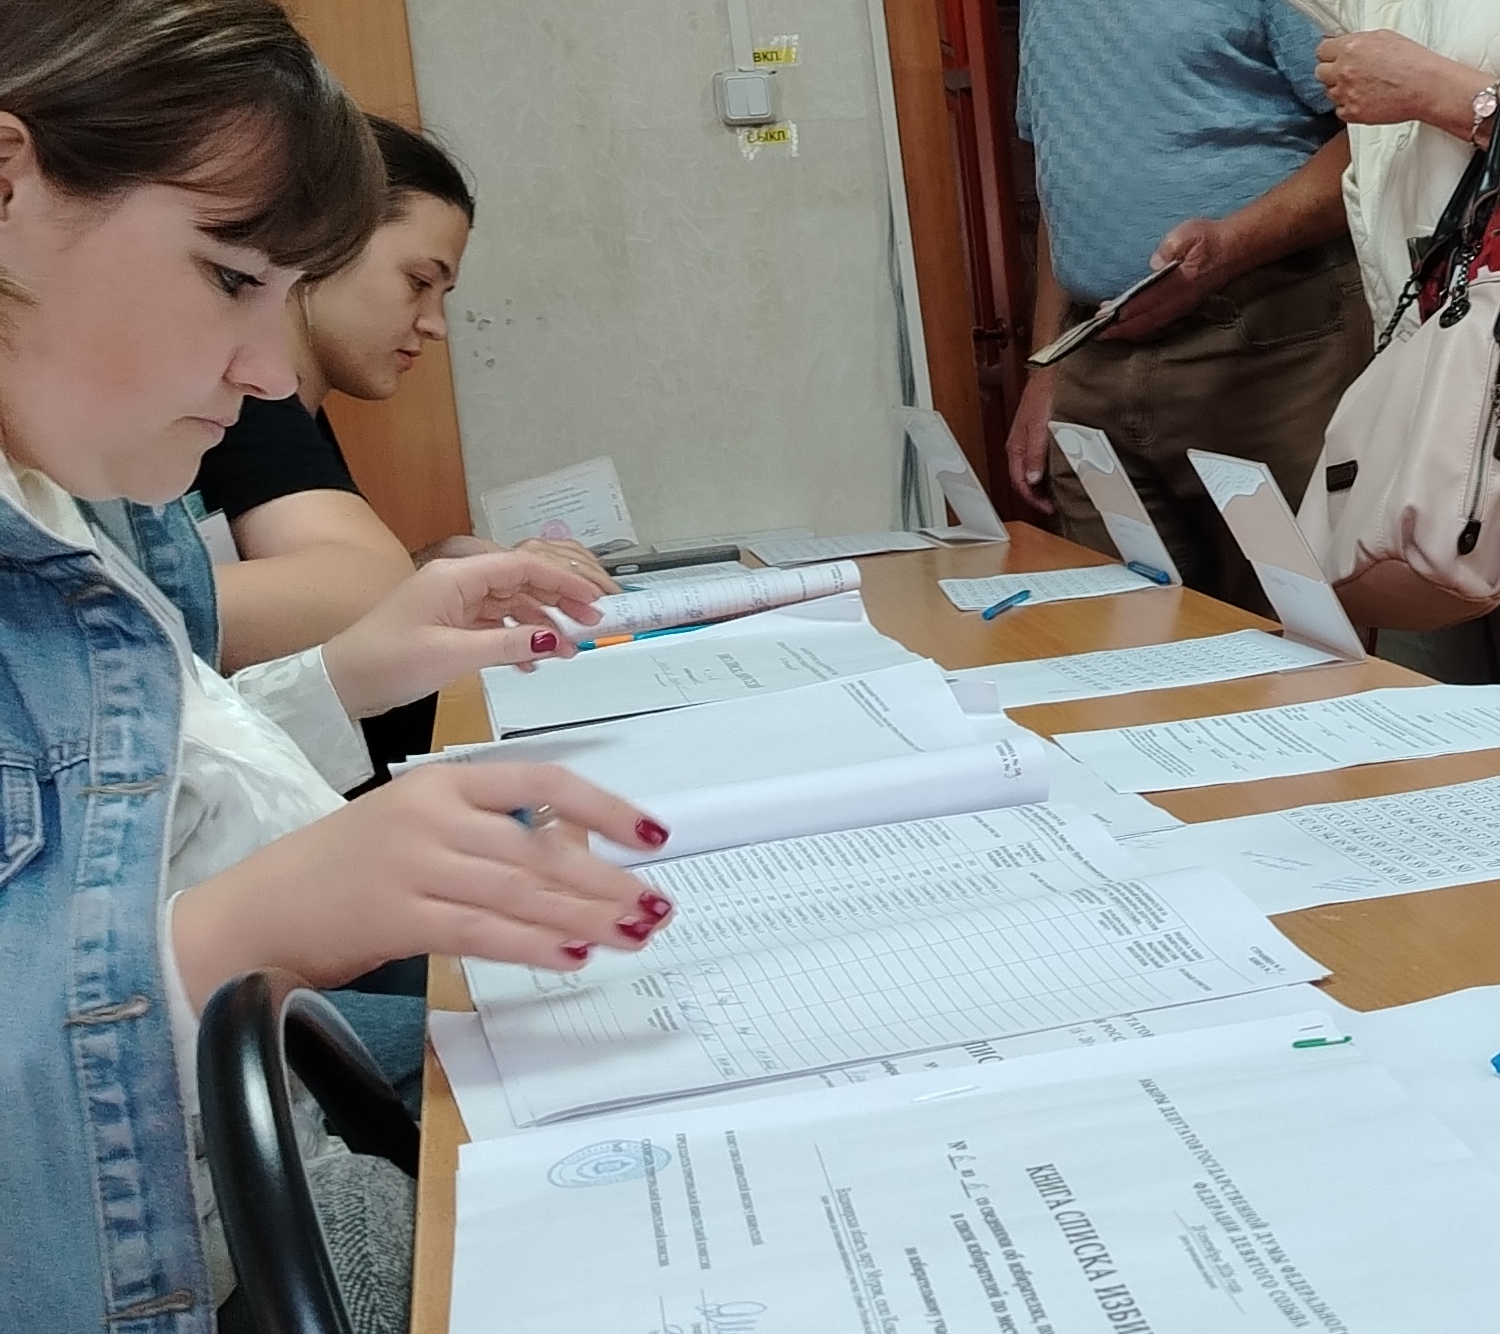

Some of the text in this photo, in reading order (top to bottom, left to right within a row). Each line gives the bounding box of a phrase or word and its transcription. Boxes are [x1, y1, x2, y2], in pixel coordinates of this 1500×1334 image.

[753, 52, 781, 63] ВКЛ.
[947, 1140, 968, 1151] №
[1158, 1106, 1204, 1150] ДЕПУТАТОВ
[1193, 1149, 1269, 1230] ГОСУДАРСТВЕННОЙ
[1253, 1231, 1290, 1264] ДУМЫ
[1025, 1163, 1076, 1210] КНИГА
[1054, 1210, 1117, 1282] СПИСКА
[966, 1242, 1008, 1299] избирателей
[1002, 1249, 1026, 1261] об
[1193, 1181, 1242, 1233] ФЕДЕРАЦИИ
[1229, 1235, 1279, 1289] ДЕВЯТОГО
[1268, 1290, 1310, 1329] СОЗЫВА
[860, 1269, 885, 1300] Муром,
[1008, 1261, 1047, 1324] избирателях,
